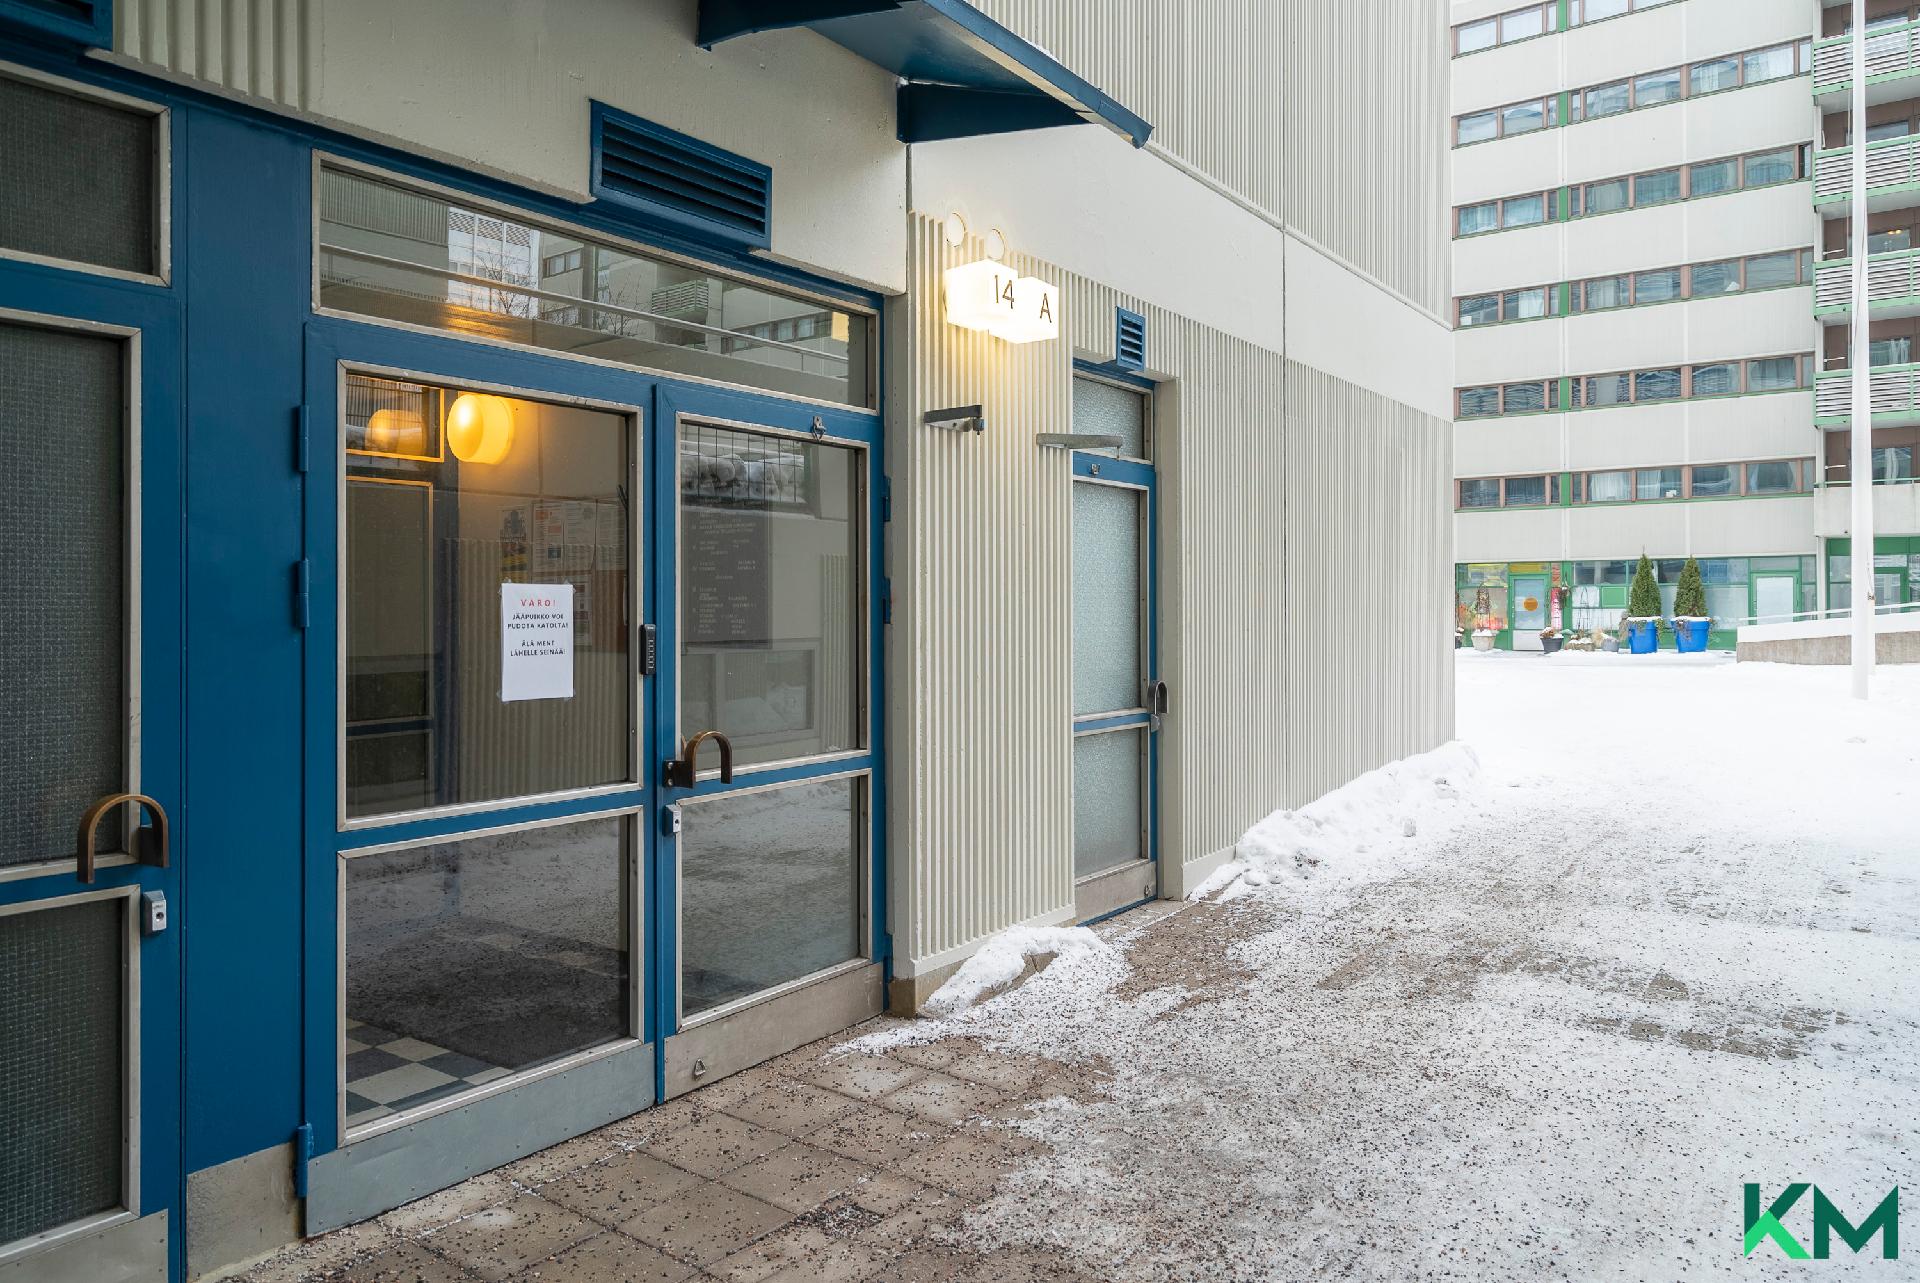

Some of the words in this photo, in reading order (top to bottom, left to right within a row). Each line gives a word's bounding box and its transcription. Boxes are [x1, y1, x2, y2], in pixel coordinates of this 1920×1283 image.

[994, 275, 1014, 309] 14
[1039, 293, 1052, 323] A
[520, 599, 556, 607] VARO!
